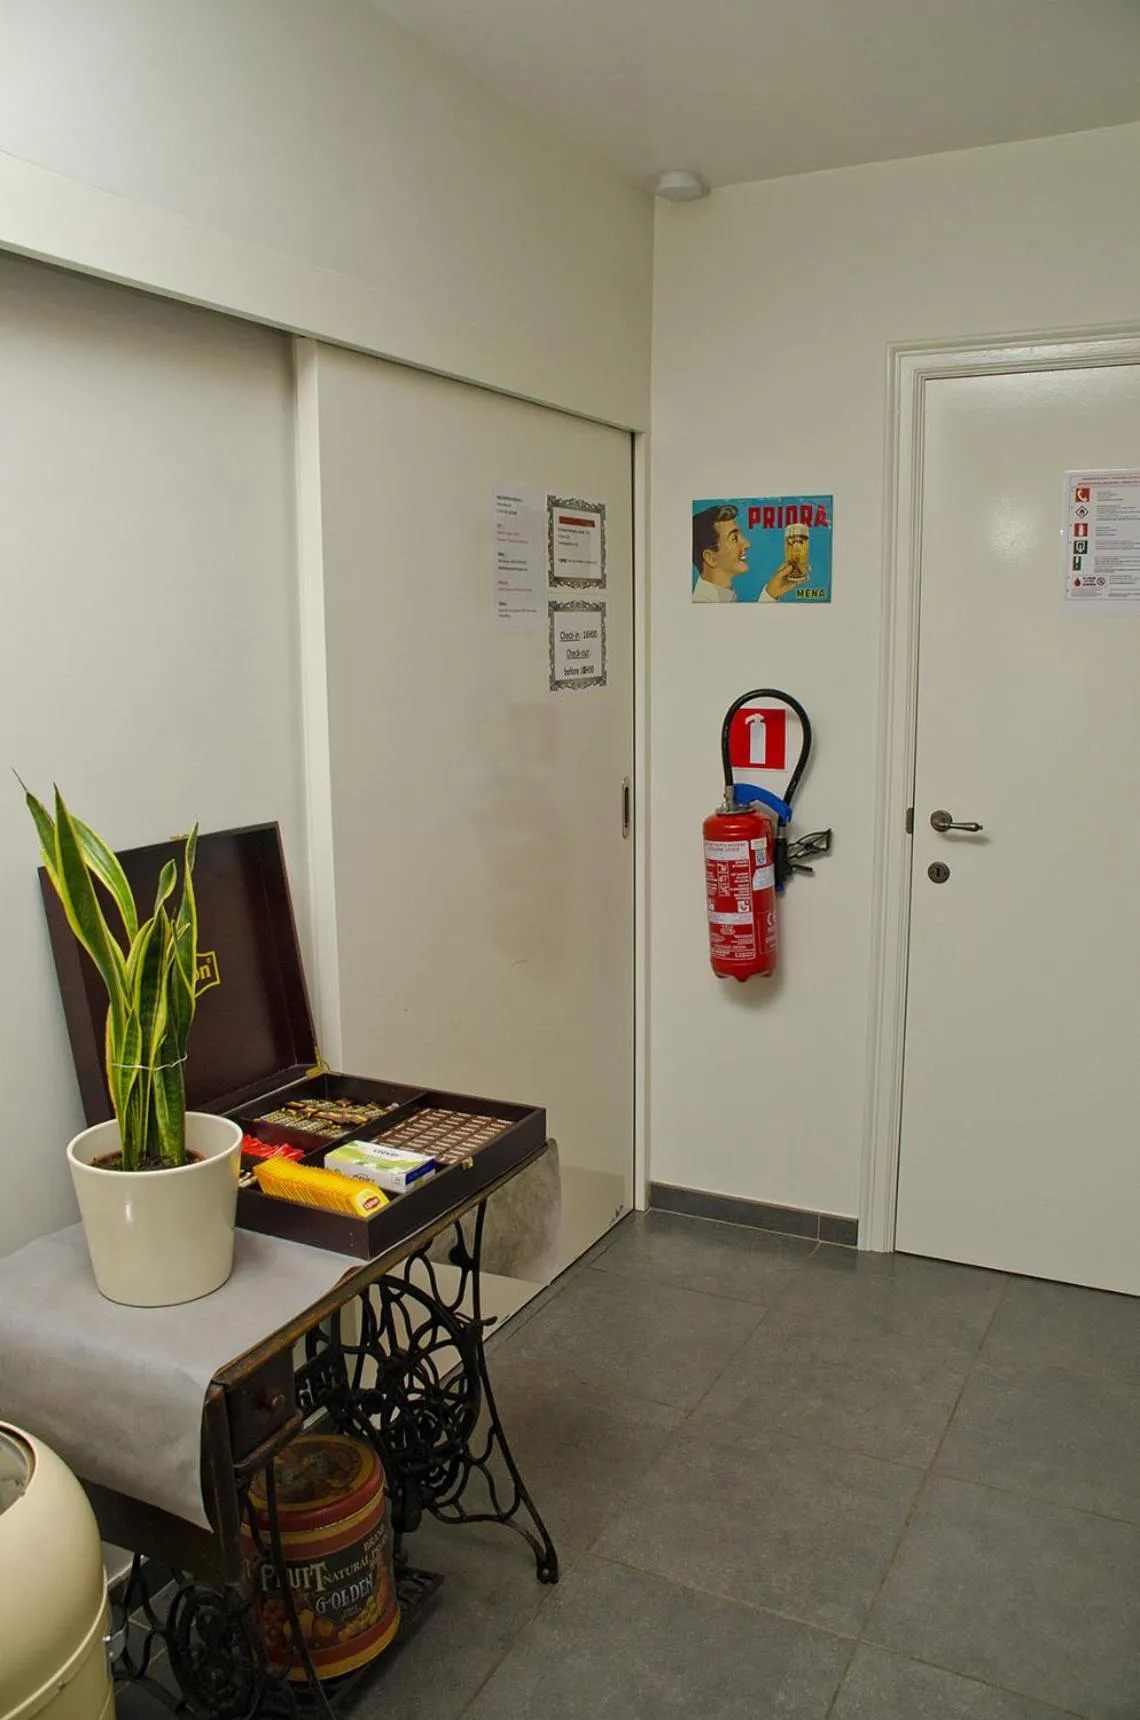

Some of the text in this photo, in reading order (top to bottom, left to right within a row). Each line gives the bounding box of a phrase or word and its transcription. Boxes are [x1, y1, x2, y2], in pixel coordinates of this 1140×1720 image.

[796, 588, 826, 598] MENA
[260, 1561, 328, 1592] FUIT
[315, 1572, 375, 1614] GOLDEN
